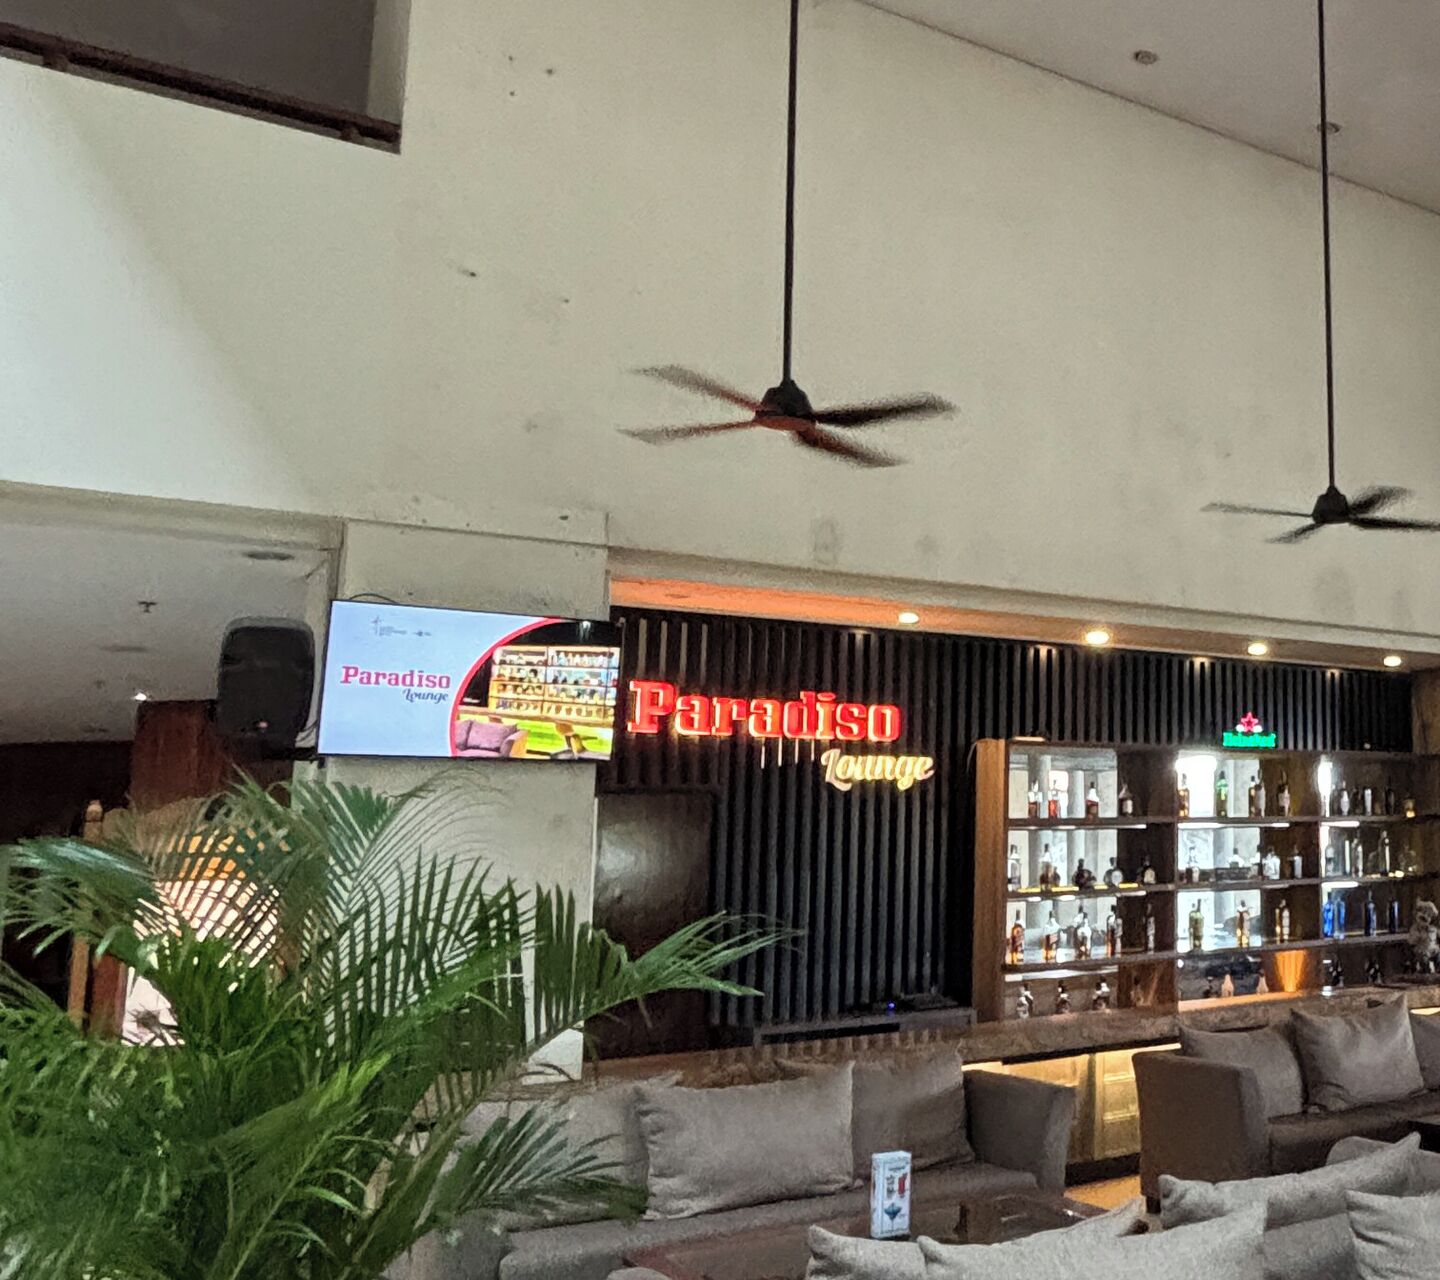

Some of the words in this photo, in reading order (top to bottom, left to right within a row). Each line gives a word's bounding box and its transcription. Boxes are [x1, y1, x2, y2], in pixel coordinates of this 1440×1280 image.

[340, 665, 452, 689] Paradiso
[402, 688, 449, 704] Lounge
[627, 680, 902, 742] Paradiso
[821, 749, 934, 791] Lounge
